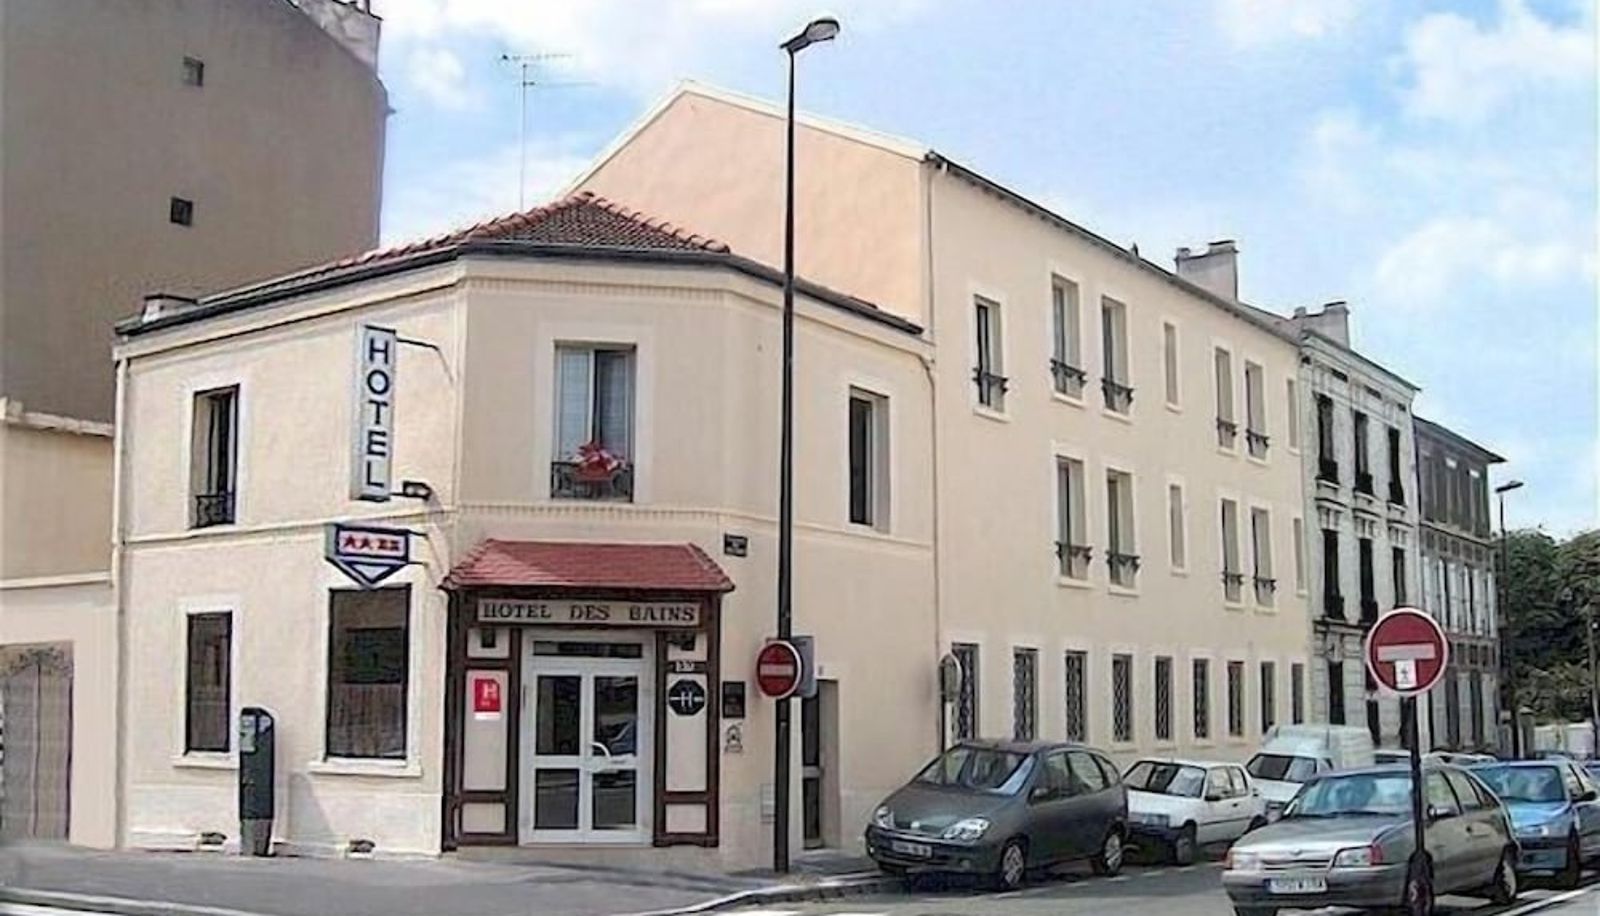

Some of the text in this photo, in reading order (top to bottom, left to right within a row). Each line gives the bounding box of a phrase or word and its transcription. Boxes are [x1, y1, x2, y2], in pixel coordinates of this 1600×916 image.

[366, 337, 390, 488] HOTEL
[483, 603, 695, 622] HOTEL DES BAINS
